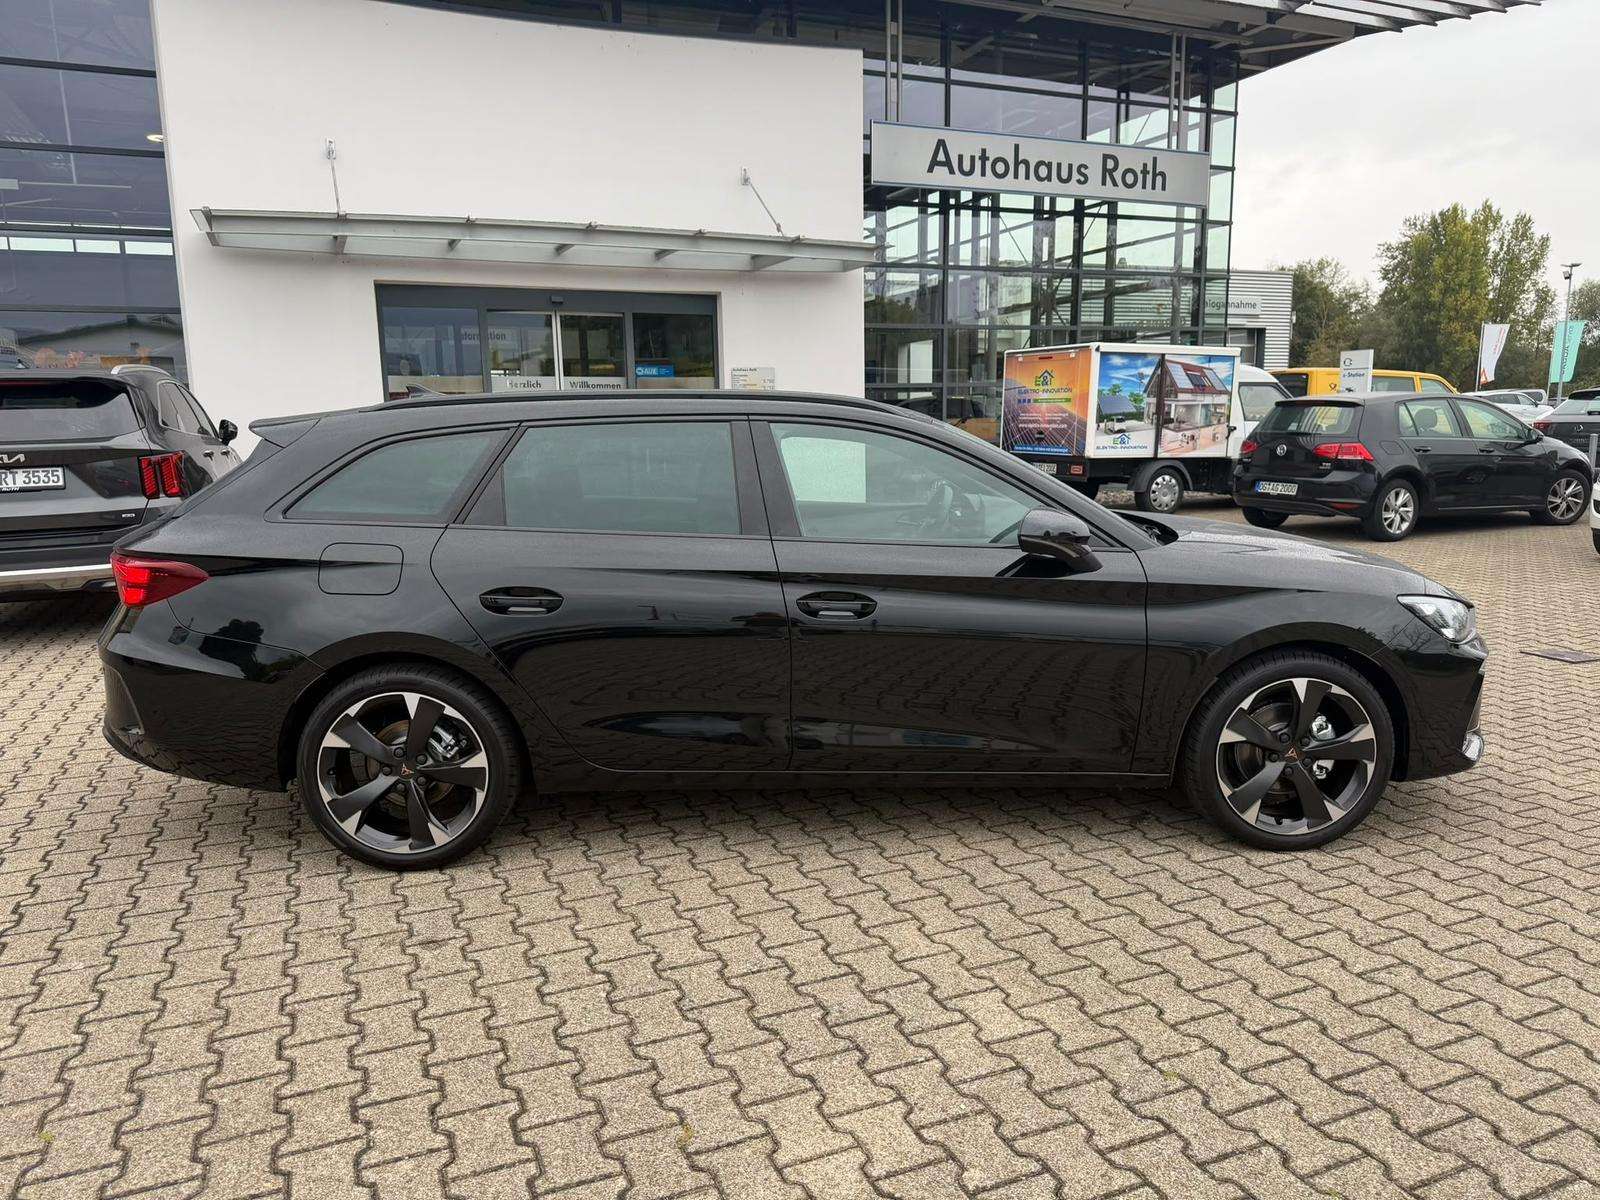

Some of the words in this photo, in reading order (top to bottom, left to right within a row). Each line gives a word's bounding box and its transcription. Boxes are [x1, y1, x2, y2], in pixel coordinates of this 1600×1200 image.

[926, 138, 1089, 186] Autohaus
[1101, 153, 1167, 191] Roth
[569, 380, 622, 390] Willkommen
[22, 469, 61, 485] 3535
